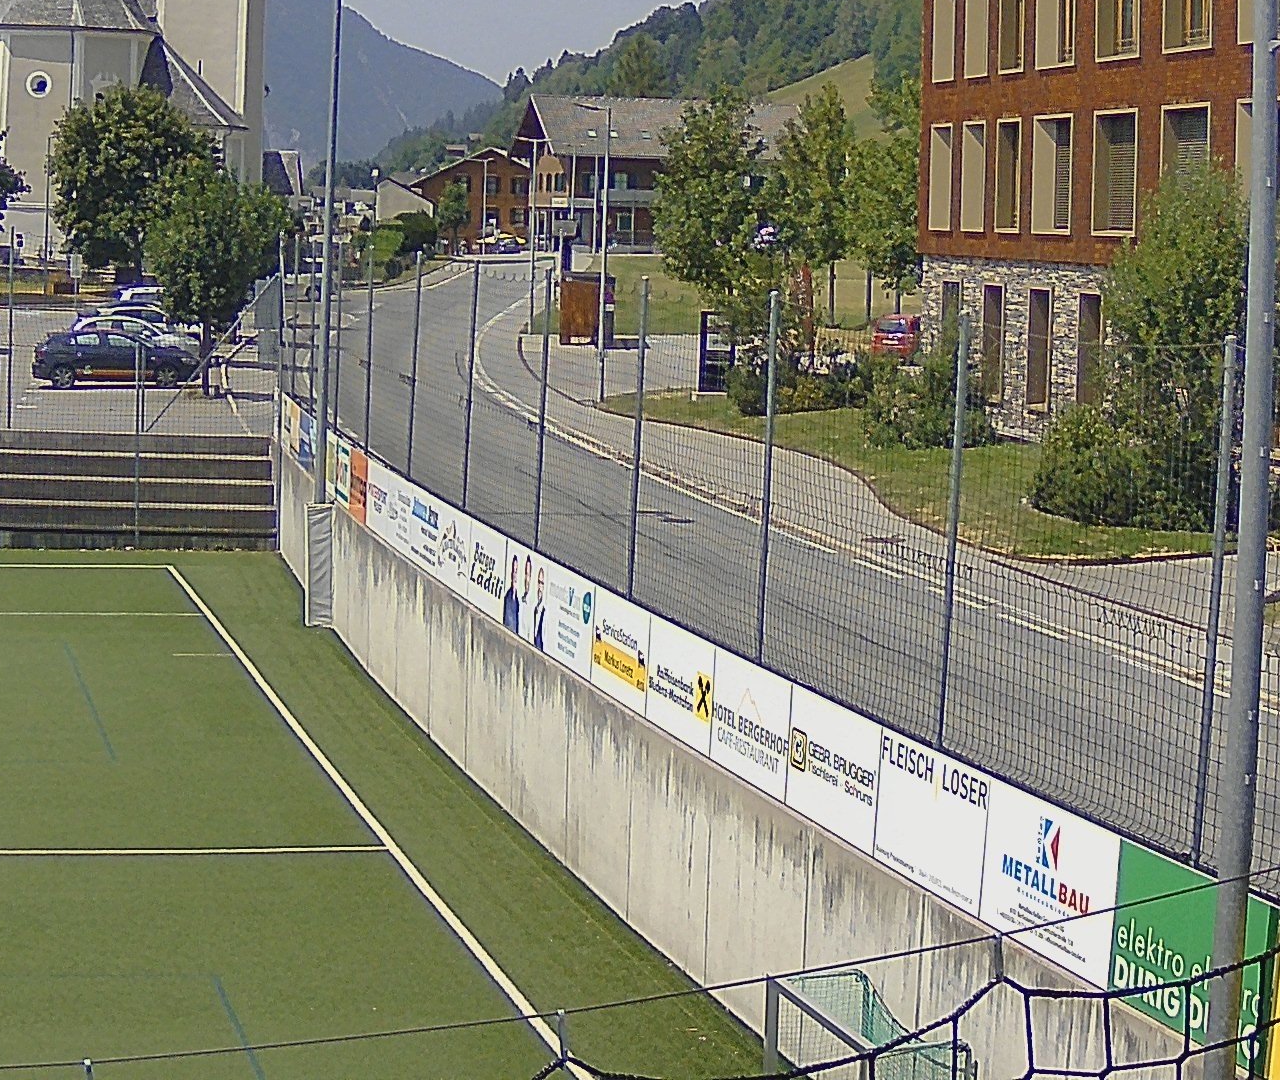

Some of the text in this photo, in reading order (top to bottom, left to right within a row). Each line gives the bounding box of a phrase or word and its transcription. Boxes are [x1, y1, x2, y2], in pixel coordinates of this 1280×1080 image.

[712, 701, 790, 757] HOTEL BERGERHOF
[807, 759, 873, 807] Tischlerei Schruns
[808, 741, 875, 790] GEBR. BRUGGER
[882, 735, 988, 810] FLEISCH LOSER
[1002, 854, 1090, 914] METALLBAU
[1117, 917, 1184, 978] elektro
